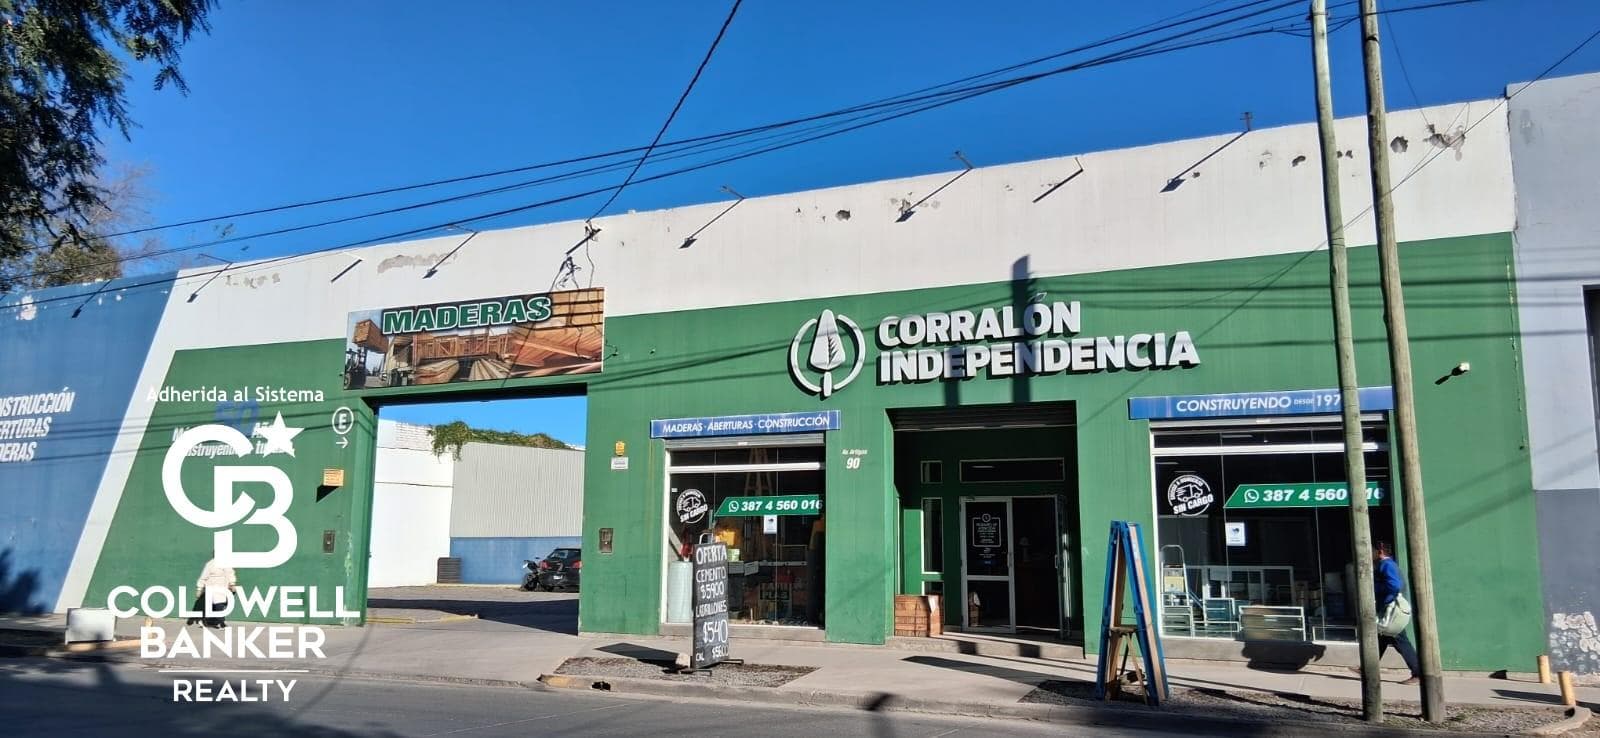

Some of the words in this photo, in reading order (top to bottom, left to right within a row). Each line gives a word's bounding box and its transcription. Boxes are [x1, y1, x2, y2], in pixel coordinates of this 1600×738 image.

[382, 296, 552, 335] MADERAS
[878, 293, 1081, 347] CORRALÓN
[880, 331, 1201, 383] INDEPENDENCIA
[1176, 395, 1291, 412] CONSTRUYENDO
[1317, 394, 1341, 407] 197
[338, 413, 347, 429] E
[663, 421, 703, 433] MADERAS
[707, 419, 754, 431] ABERTURAS
[758, 414, 830, 429] CONSTRUCCIÓN
[846, 457, 861, 469] 90
[1173, 503, 1187, 515] SIN
[1187, 493, 1214, 510] CARGO
[1262, 489, 1291, 502] 387
[1298, 489, 1311, 502] 4
[1315, 488, 1348, 501] 560
[741, 501, 762, 512] 387
[765, 501, 773, 511] 4
[776, 500, 798, 511] 560
[801, 499, 823, 510] 016
[696, 544, 728, 565] OFERTA
[696, 566, 727, 583] CEMENTO
[702, 620, 729, 644] $540
